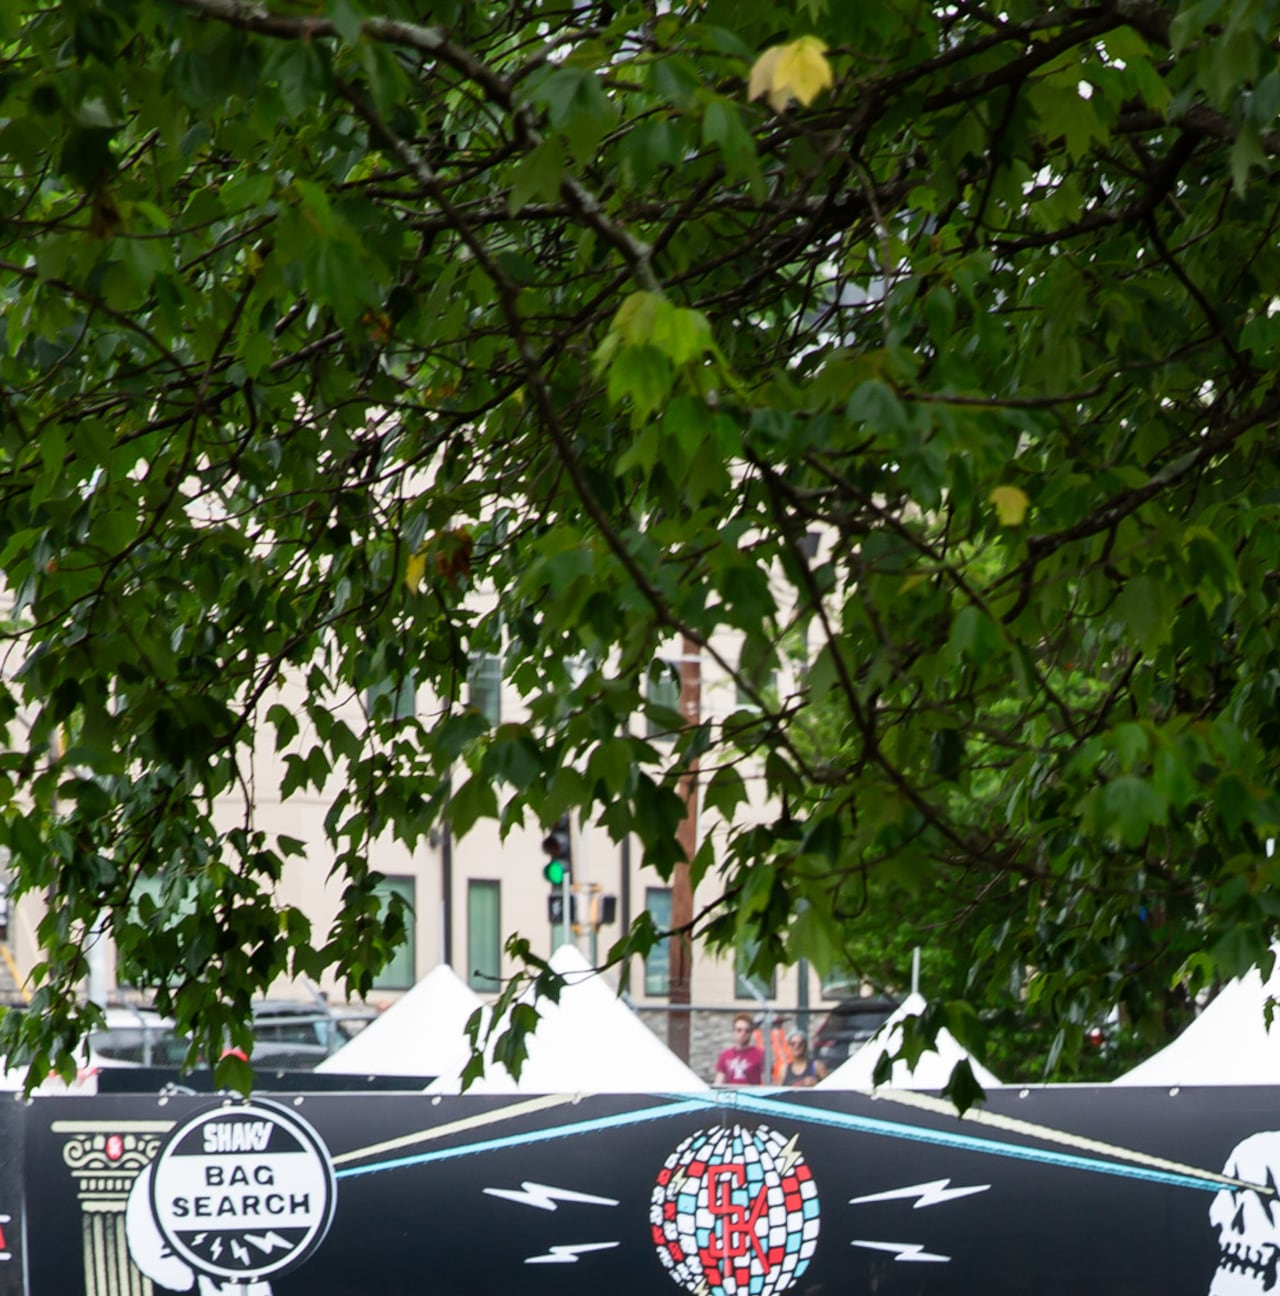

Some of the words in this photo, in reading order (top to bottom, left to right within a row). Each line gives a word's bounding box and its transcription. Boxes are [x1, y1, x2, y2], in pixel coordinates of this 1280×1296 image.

[203, 1121, 274, 1152] SHAKY
[205, 1165, 275, 1187] BAG
[172, 1193, 310, 1218] SEARCH
